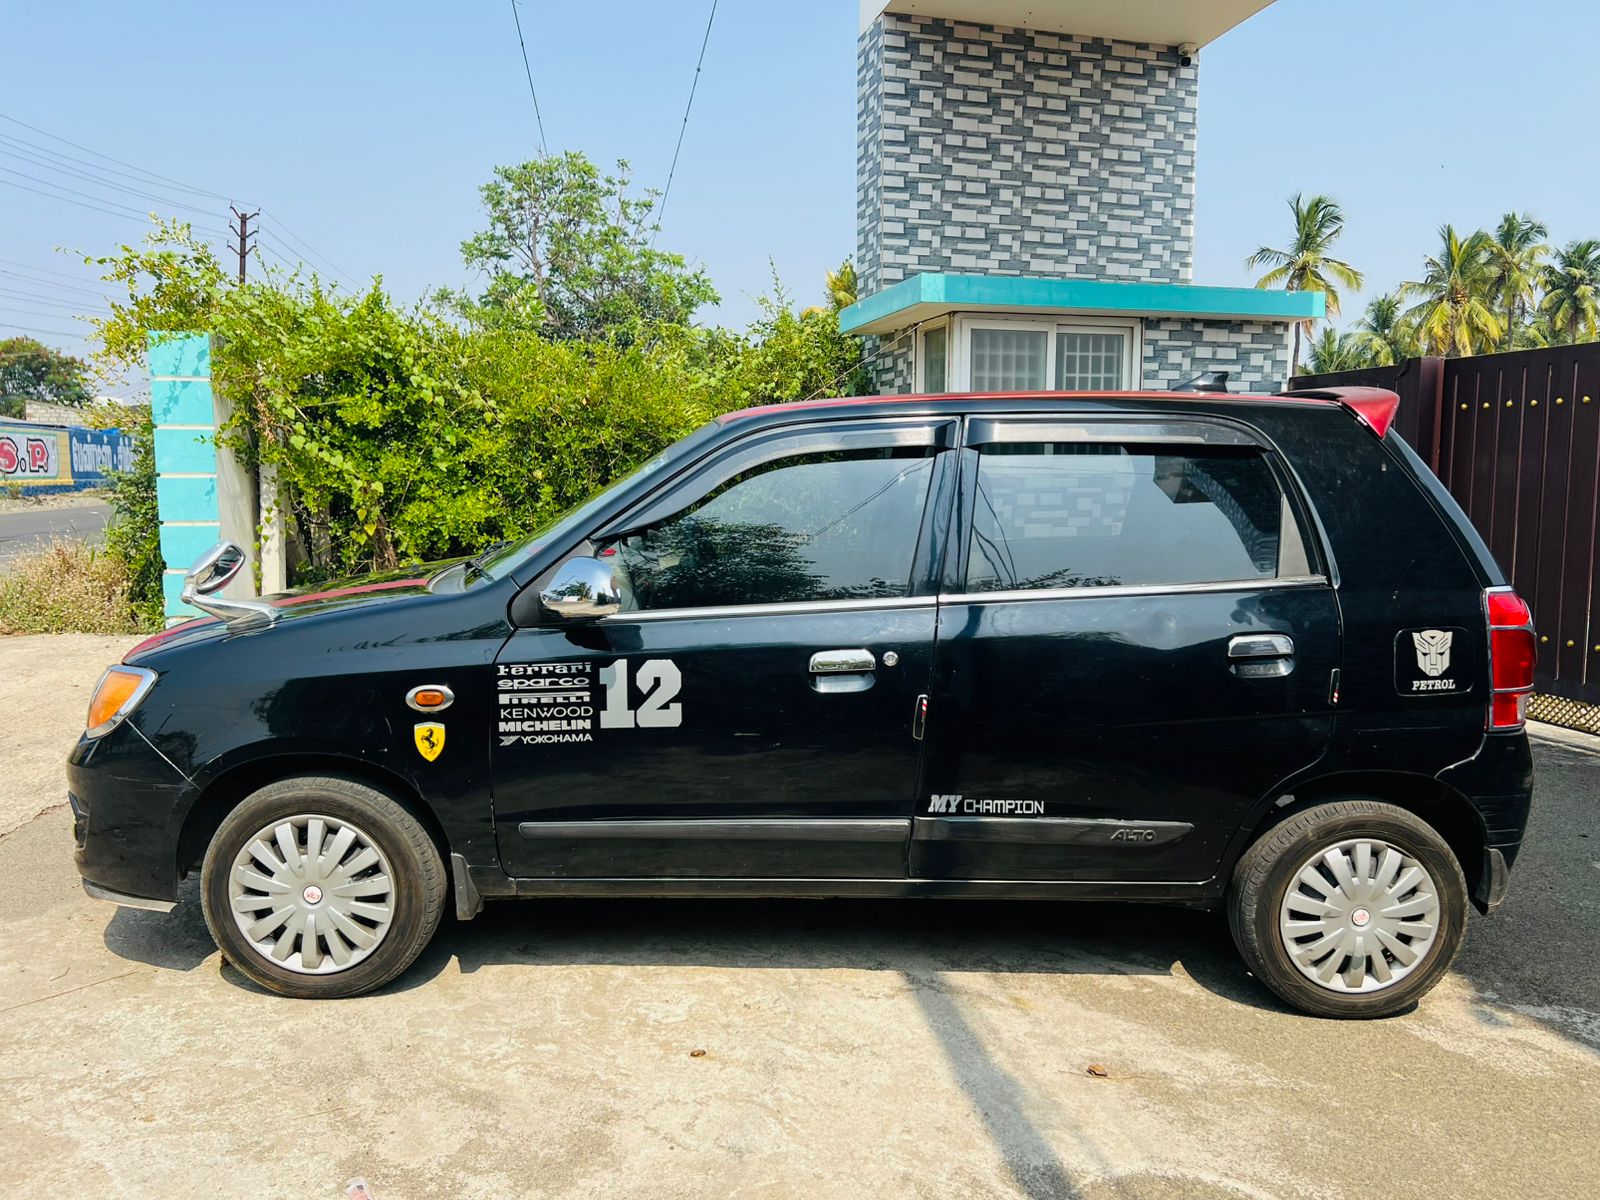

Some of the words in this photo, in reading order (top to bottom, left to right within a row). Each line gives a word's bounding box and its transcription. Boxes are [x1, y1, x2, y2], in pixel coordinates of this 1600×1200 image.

[497, 677, 590, 690] sparco
[1411, 679, 1456, 691] PETROL
[498, 691, 591, 705] PIRELLI
[599, 658, 683, 729] 12
[500, 706, 593, 719] KENWOOD
[498, 719, 591, 732] MICHELIN
[520, 733, 593, 745] YOKOHAMA
[928, 794, 962, 813] MY
[963, 799, 1045, 814] CHAMPION
[1109, 829, 1157, 843] ALTO
